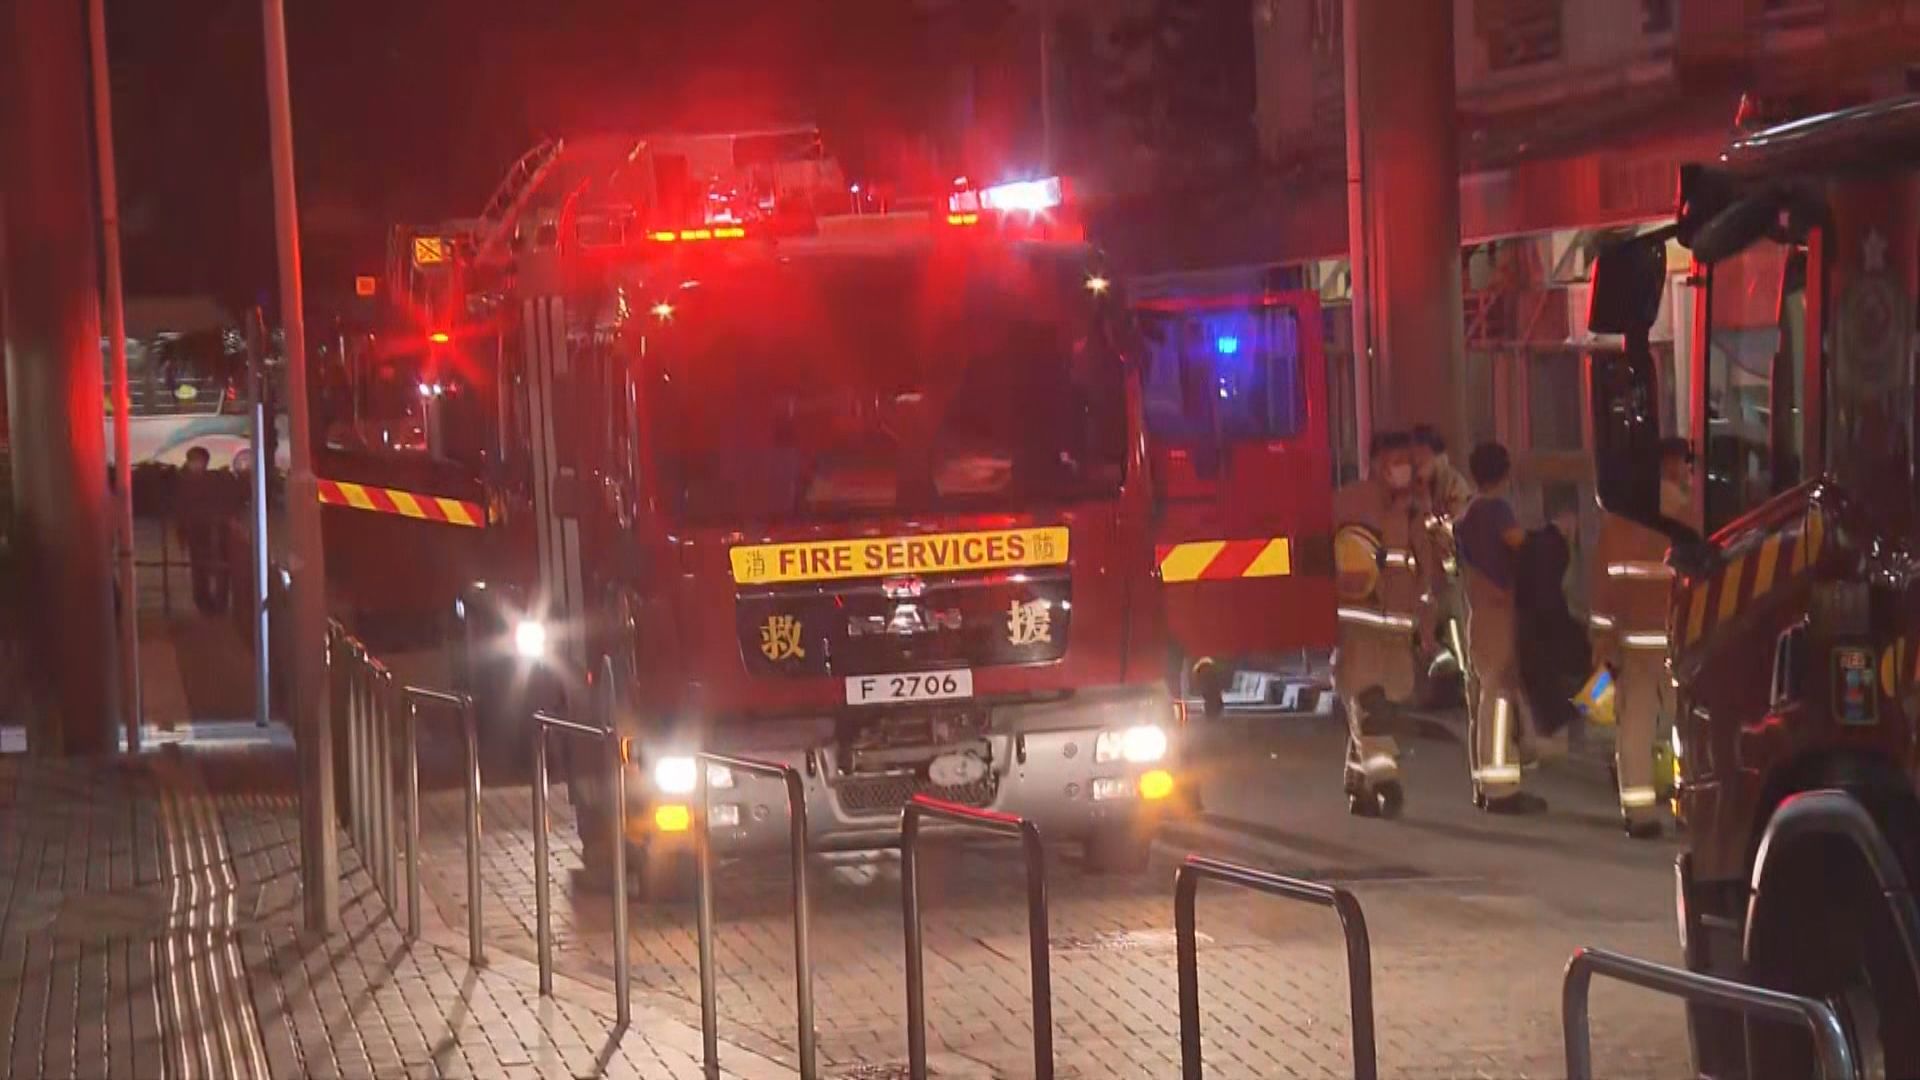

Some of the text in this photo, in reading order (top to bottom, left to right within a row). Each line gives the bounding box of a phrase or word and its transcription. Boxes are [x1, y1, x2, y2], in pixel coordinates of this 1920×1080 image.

[779, 533, 1025, 576] FIRE SERVICES
[759, 614, 805, 661] 救
[1006, 599, 1051, 646] 援
[861, 674, 957, 700] F 2706
